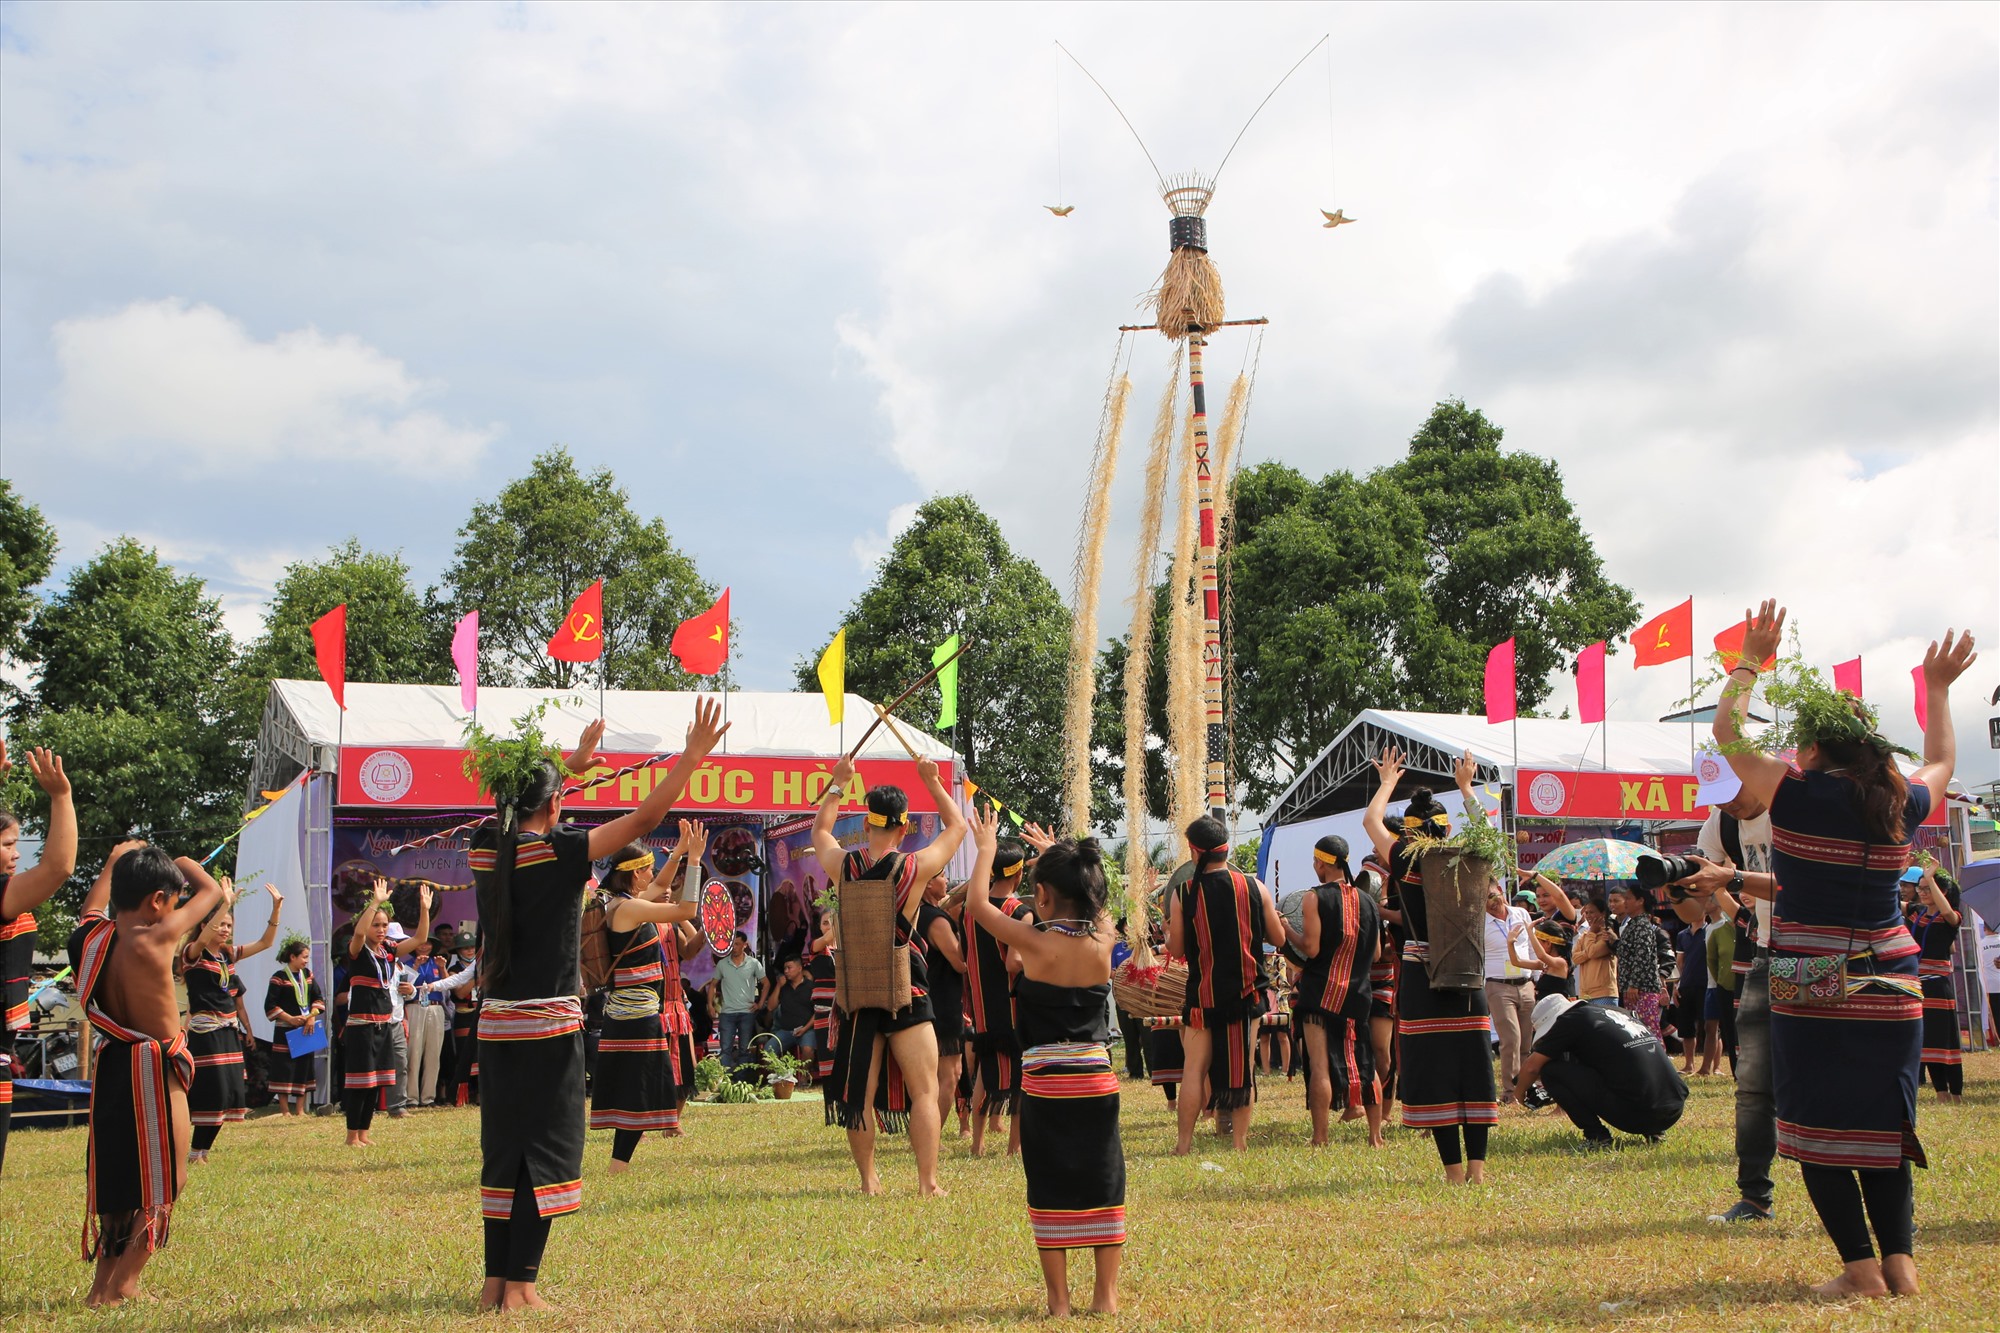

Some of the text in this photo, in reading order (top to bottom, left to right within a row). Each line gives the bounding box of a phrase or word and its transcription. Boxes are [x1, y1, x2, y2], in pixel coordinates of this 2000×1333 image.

[773, 763, 868, 806] HÒA
[1619, 776, 1671, 812] XÃ
[414, 858, 451, 870] HUYỆN
